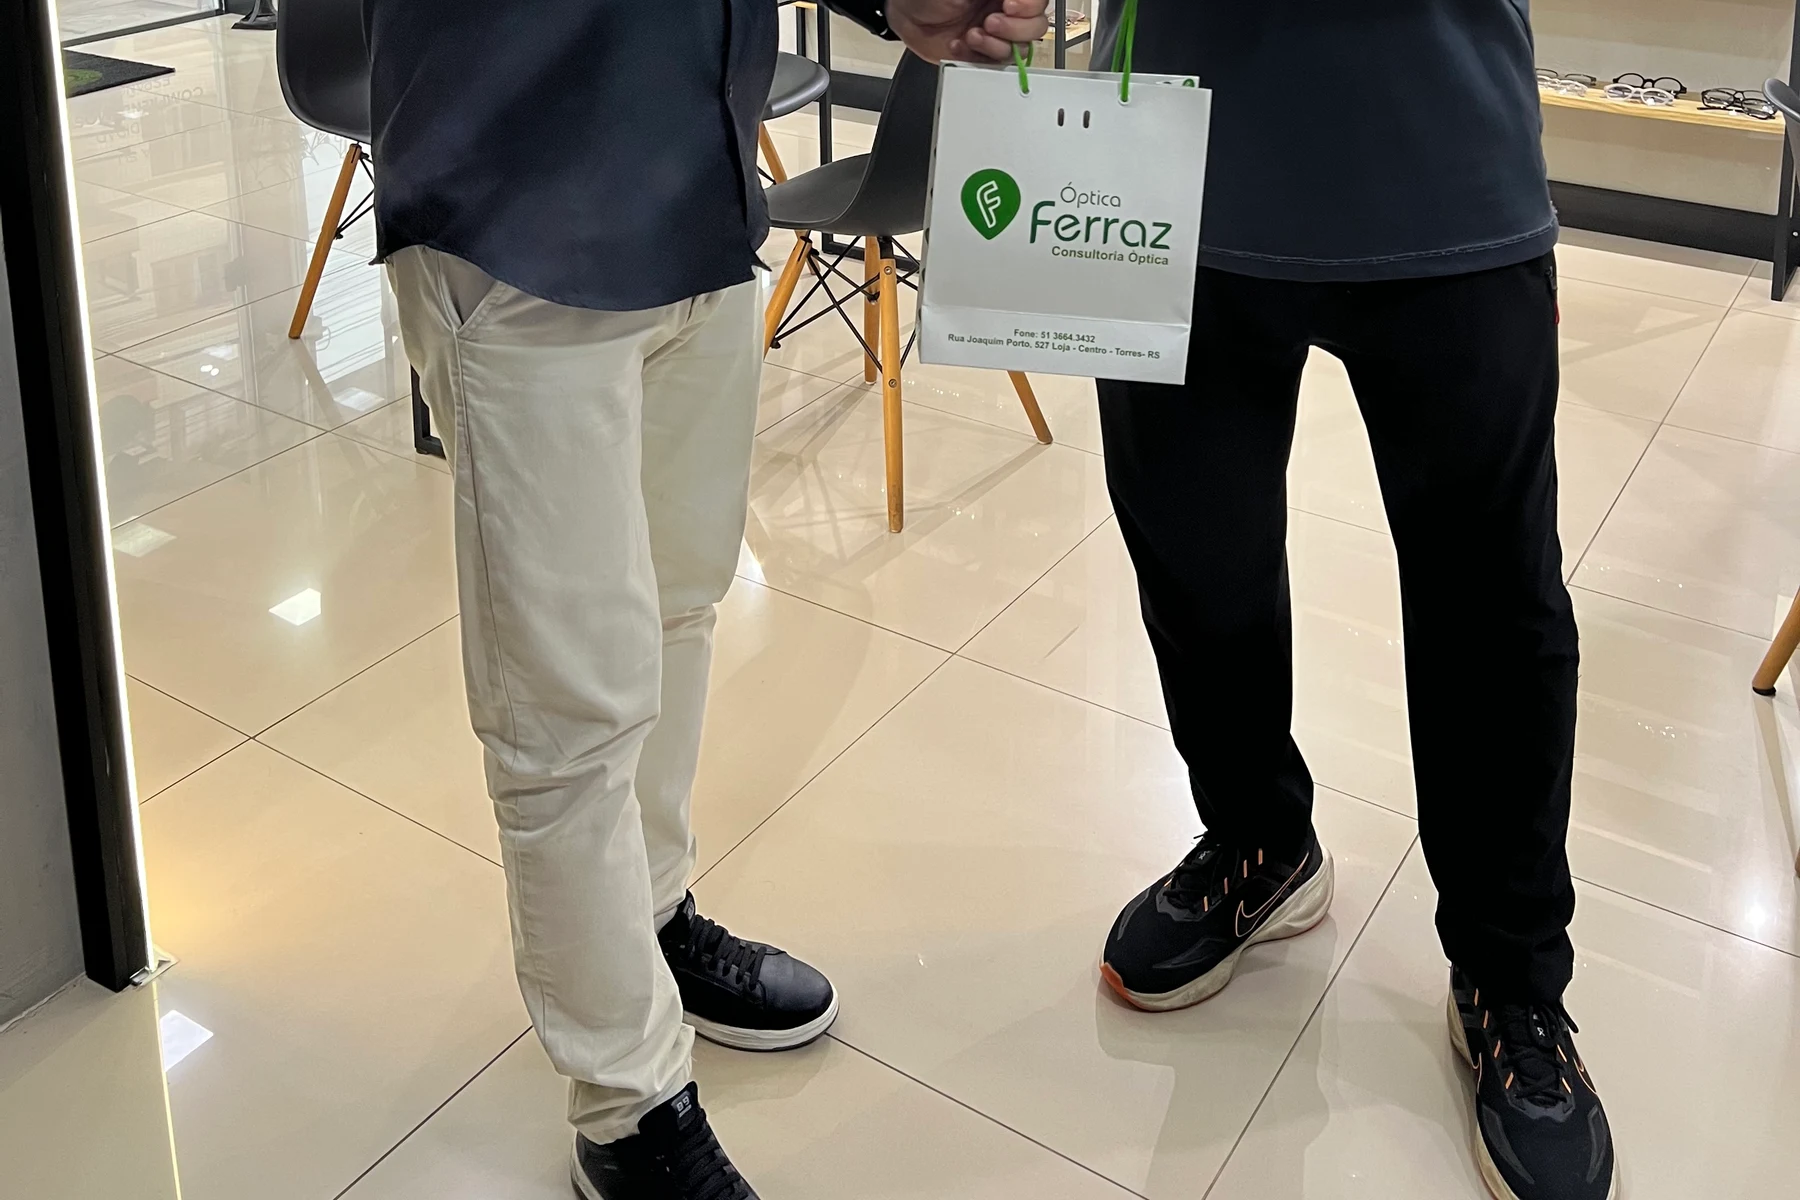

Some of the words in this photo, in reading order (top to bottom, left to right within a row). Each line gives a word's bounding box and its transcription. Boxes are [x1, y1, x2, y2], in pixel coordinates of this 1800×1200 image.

[1060, 181, 1121, 208] Óptica
[1030, 200, 1173, 250] Ferraz
[1051, 246, 1124, 262] Consultoria
[948, 333, 965, 342] Rua
[967, 335, 1004, 346] Joaquim
[1034, 341, 1050, 349] 527
[1052, 342, 1071, 353] Loja
[1078, 344, 1107, 354] Centro
[1147, 350, 1160, 359] RS
[1014, 328, 1039, 339] Fone:
[1040, 331, 1050, 339] 51
[1053, 332, 1095, 343] 3664.3432
